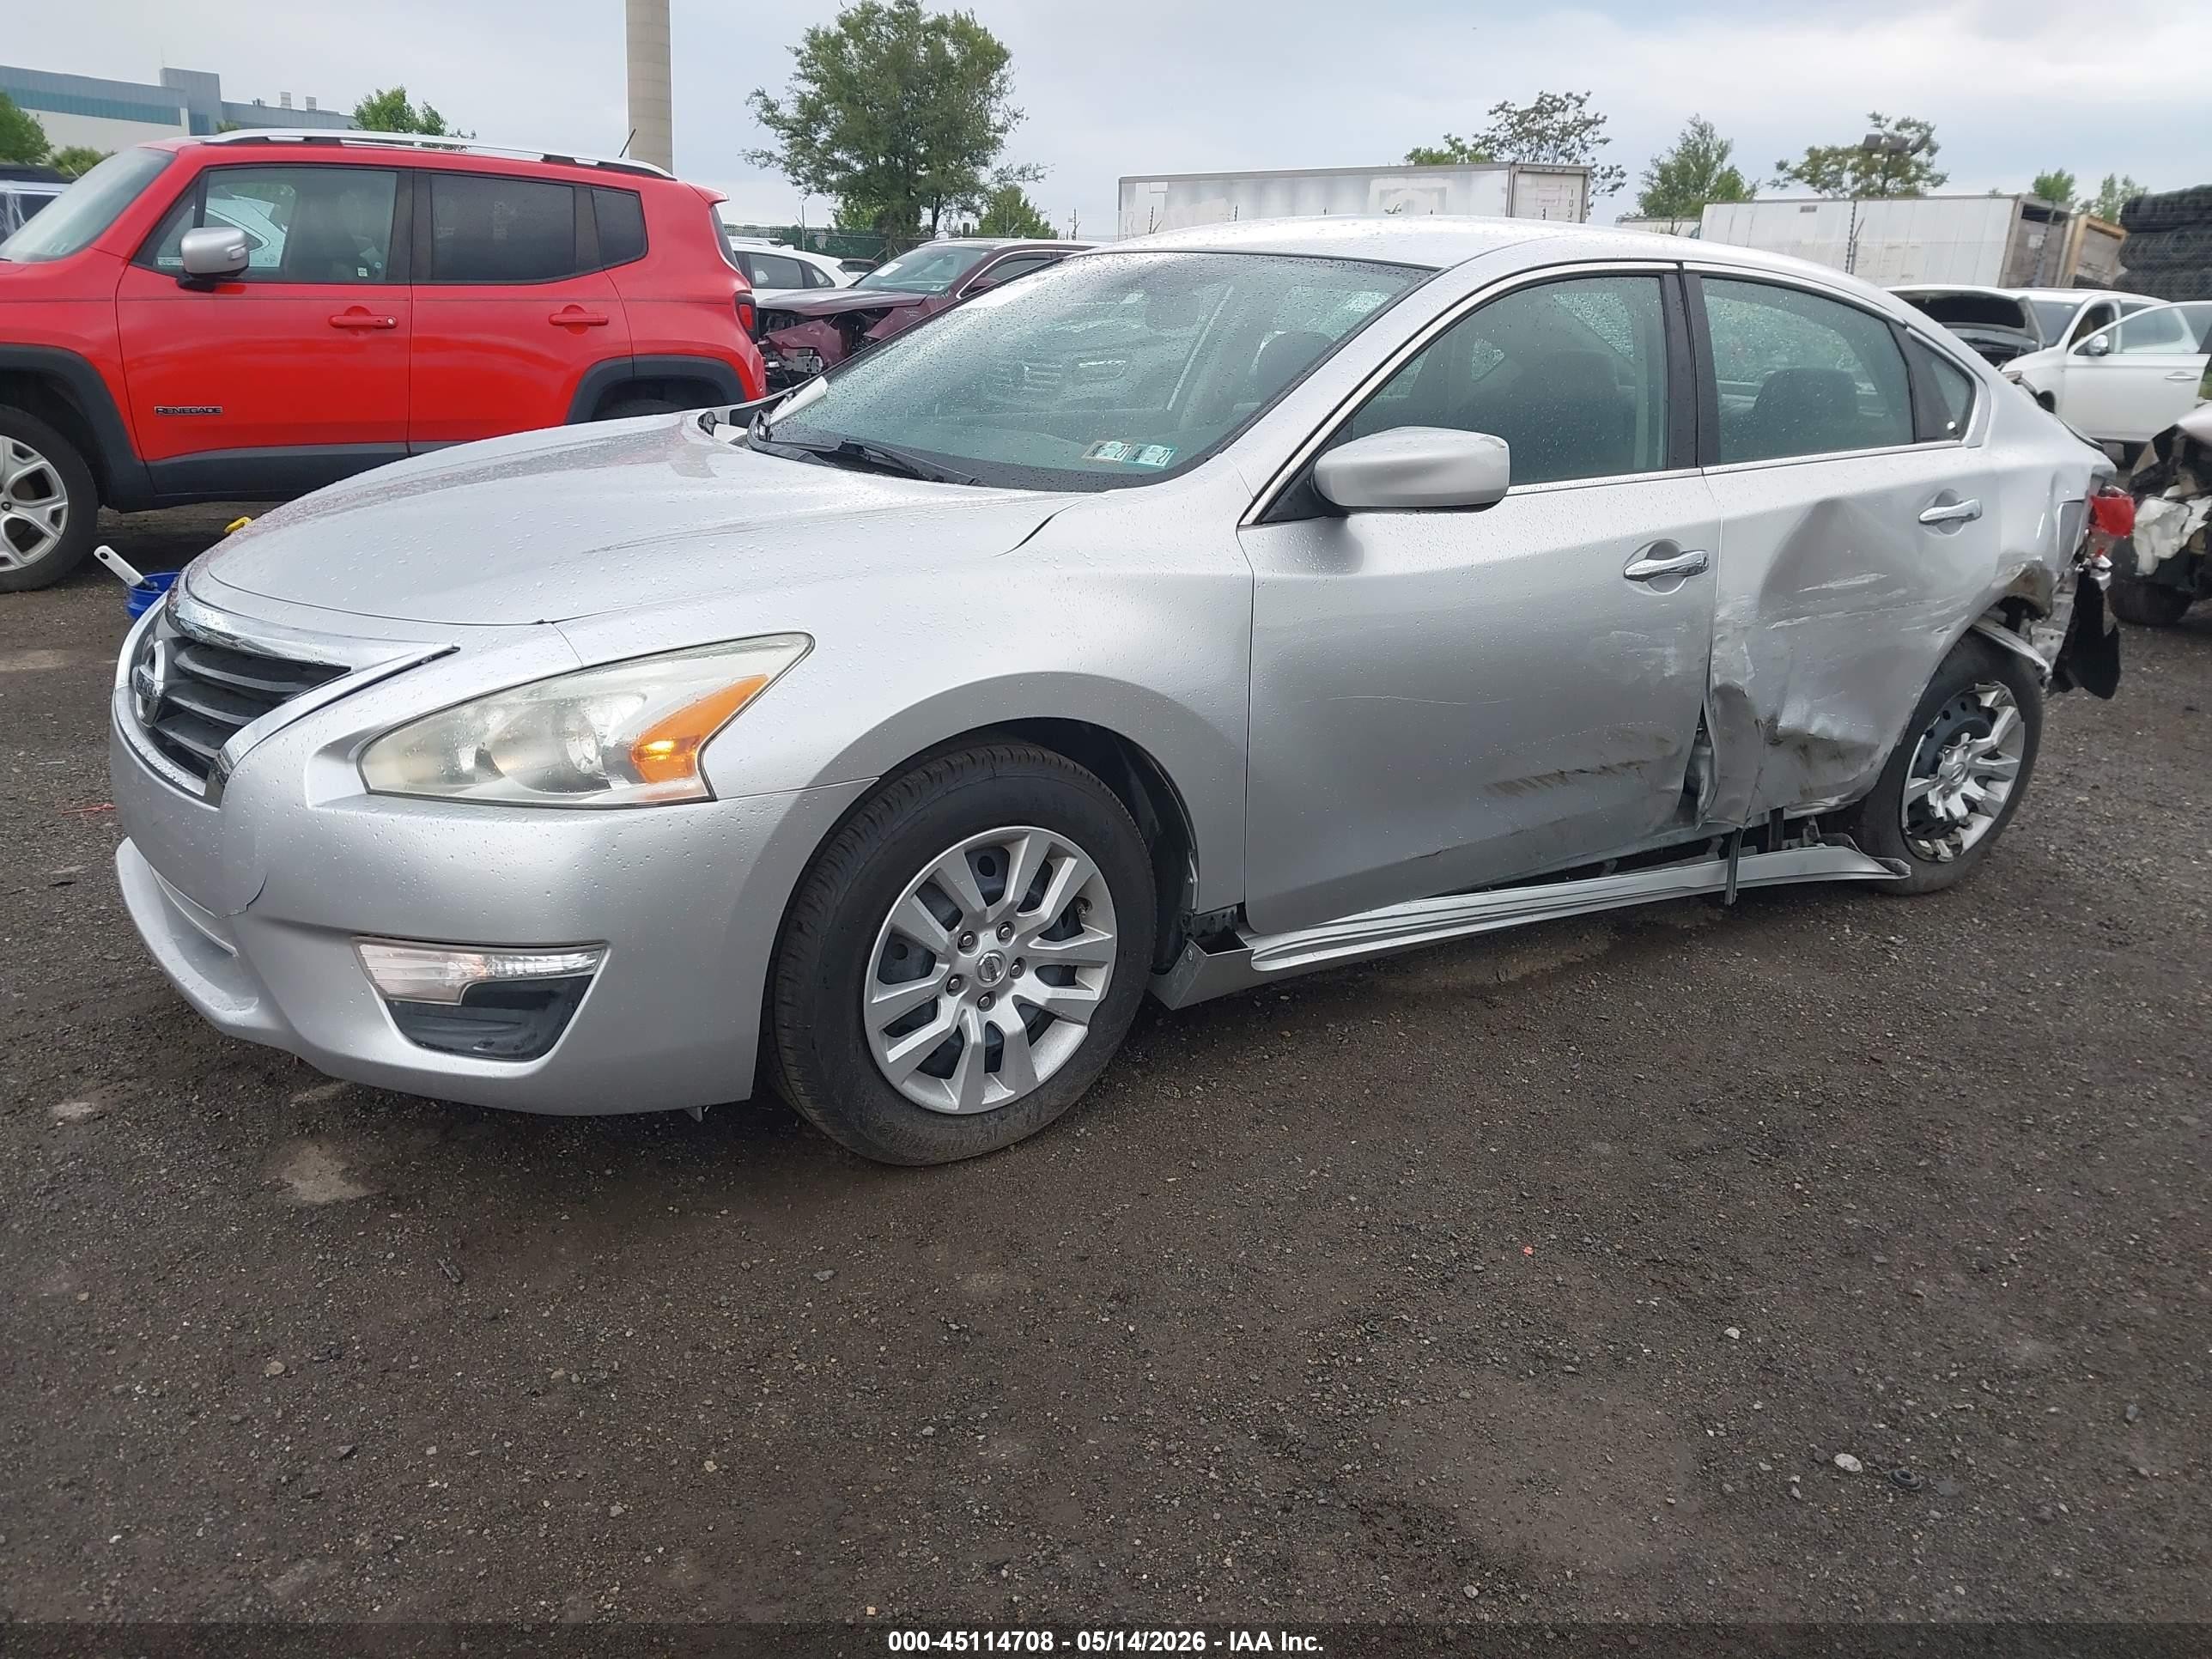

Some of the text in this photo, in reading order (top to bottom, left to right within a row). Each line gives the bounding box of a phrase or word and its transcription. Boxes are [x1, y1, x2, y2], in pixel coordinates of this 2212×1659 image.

[155, 406, 222, 415] RENEGADE
[1114, 445, 1132, 461] 27
[1155, 448, 1173, 465] 27
